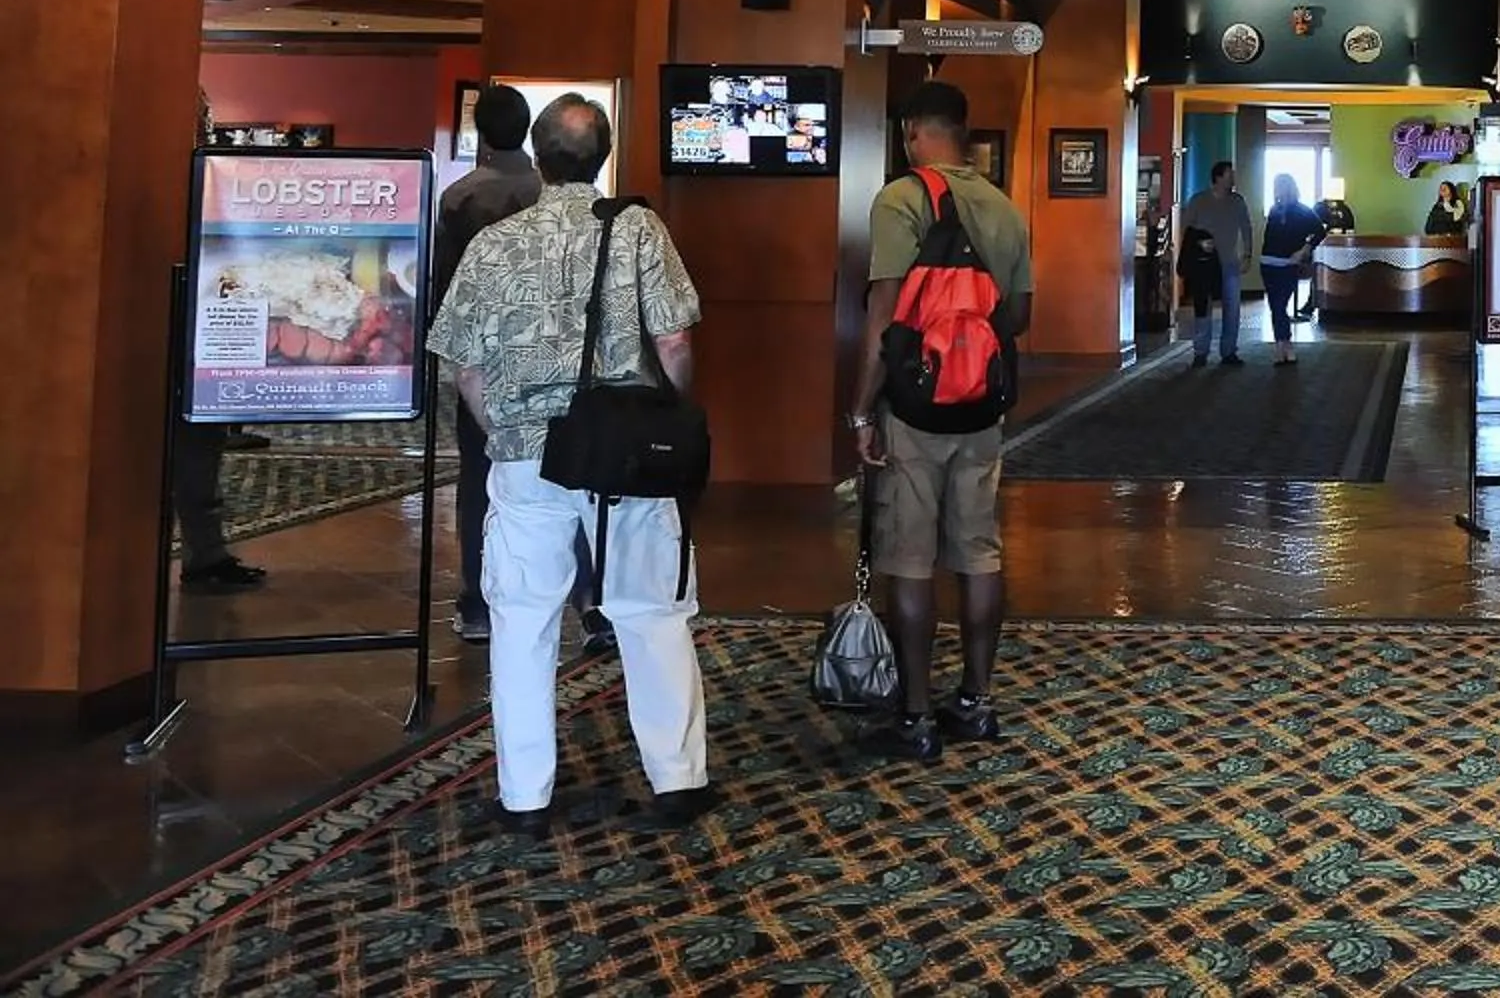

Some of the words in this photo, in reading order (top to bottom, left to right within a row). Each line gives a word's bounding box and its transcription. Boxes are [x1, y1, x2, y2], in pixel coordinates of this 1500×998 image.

[231, 176, 400, 207] LOBSTER
[303, 224, 327, 236] The
[254, 381, 332, 395] Quinault
[336, 379, 389, 393] Beach
